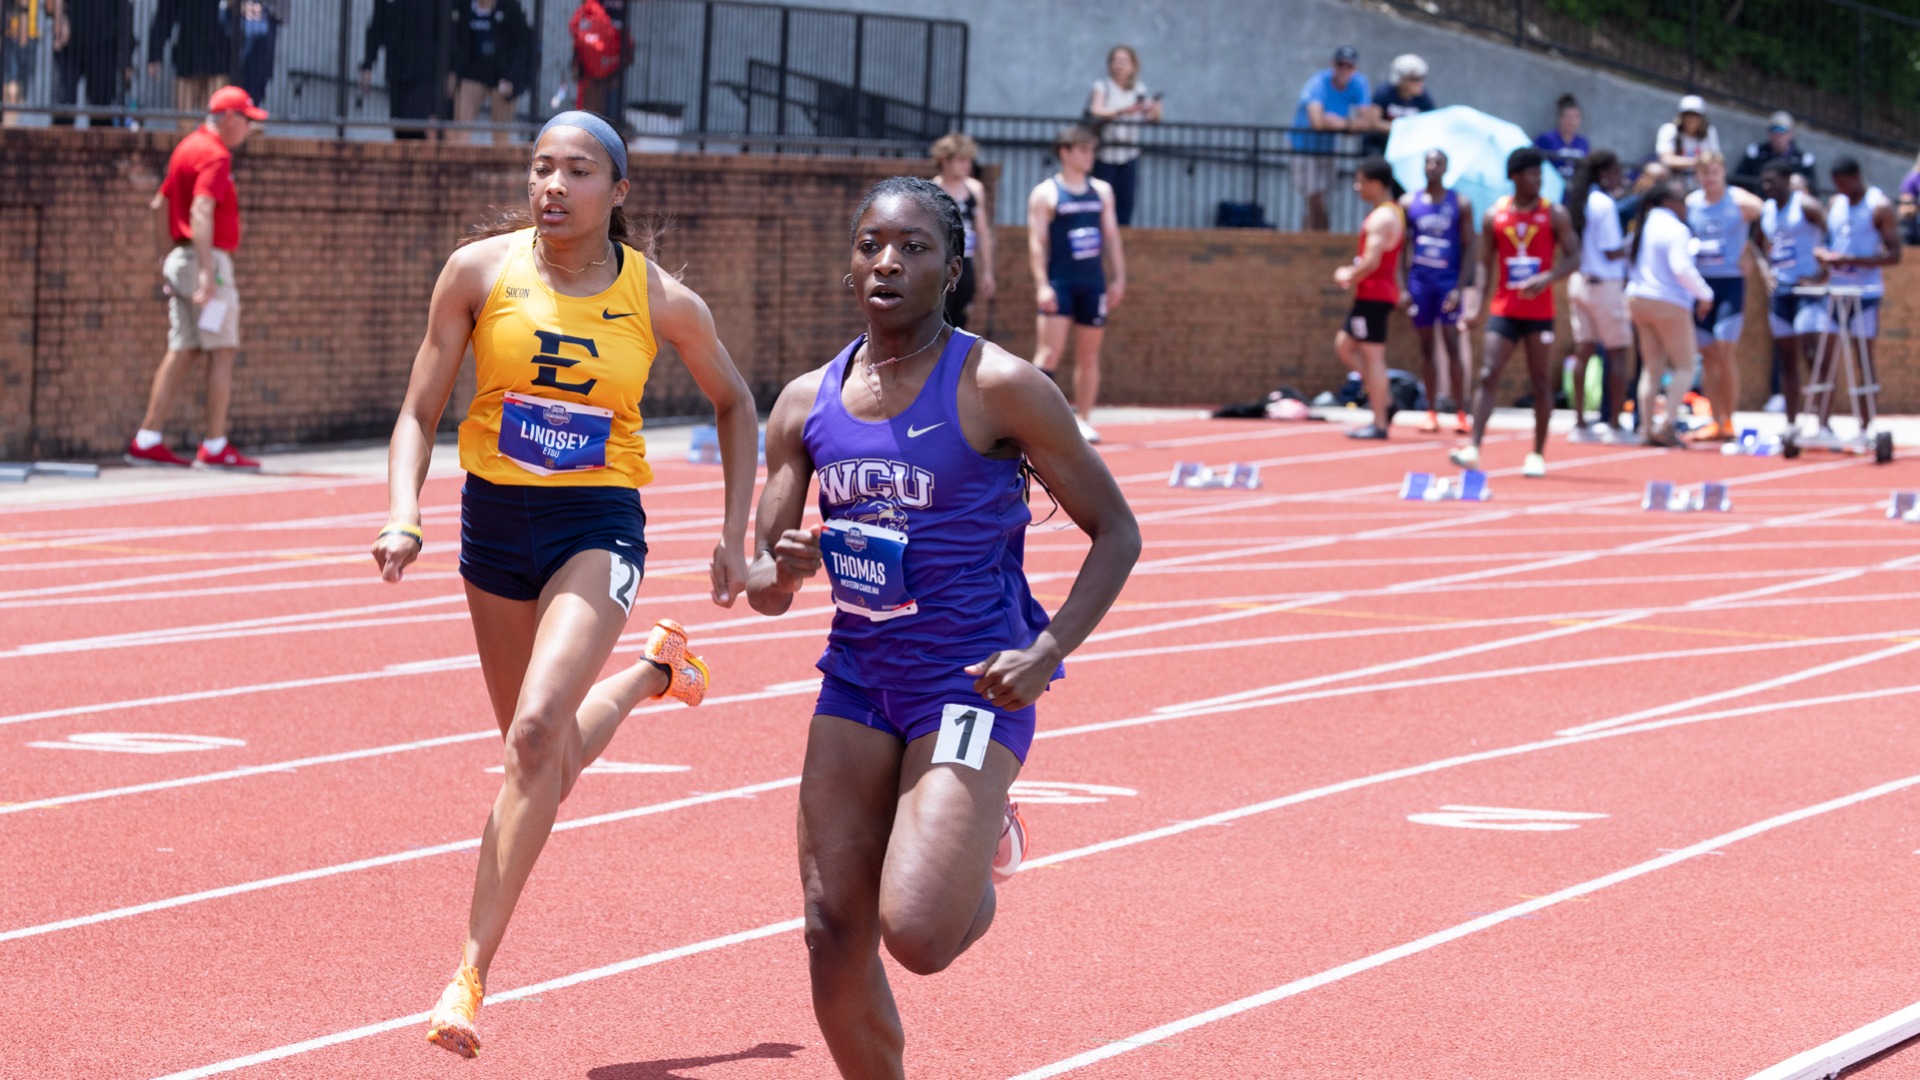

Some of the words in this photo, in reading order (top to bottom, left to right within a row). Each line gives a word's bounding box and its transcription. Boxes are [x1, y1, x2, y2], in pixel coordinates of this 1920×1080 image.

[505, 286, 531, 299] SOCON
[530, 329, 600, 396] E
[520, 420, 590, 450] LINDSEY
[542, 446, 560, 459] ETSU
[818, 458, 935, 510] WCU
[616, 557, 635, 610] 2
[830, 551, 886, 586] THOMAS
[840, 578, 860, 591] WESTERN
[859, 583, 880, 595] CAROLINA
[954, 709, 978, 761] 1
